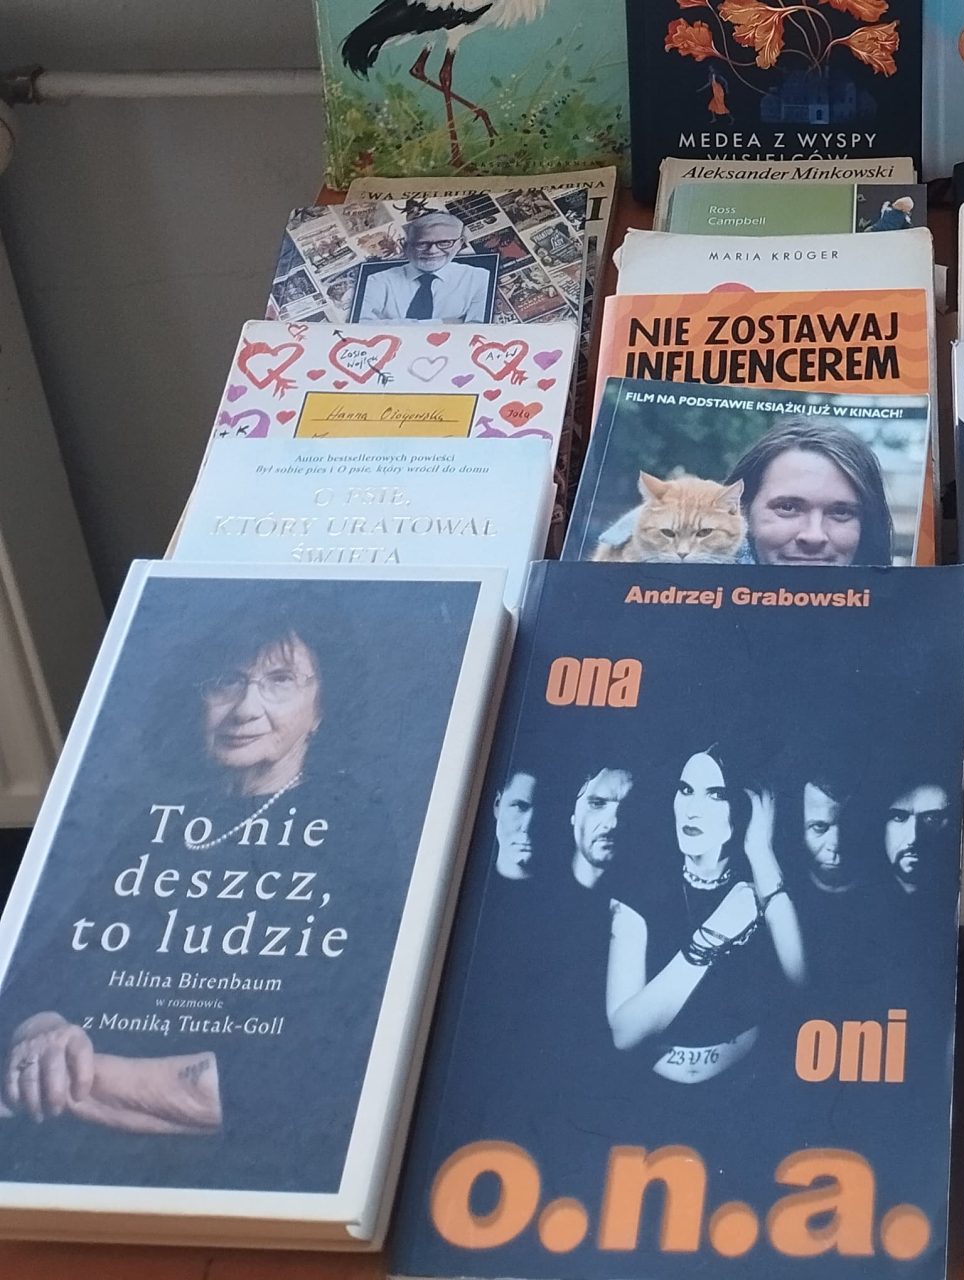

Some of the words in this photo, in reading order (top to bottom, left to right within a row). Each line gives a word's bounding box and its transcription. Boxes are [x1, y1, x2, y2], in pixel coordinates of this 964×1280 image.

[679, 133, 761, 147] MEDEA
[774, 133, 785, 147] Z
[798, 133, 877, 147] WYSPY
[682, 166, 789, 180] Aleksander
[791, 165, 894, 180] Minkowski
[708, 217, 765, 226] Campbell
[709, 206, 736, 214] Ross
[709, 251, 760, 261] MARIA
[772, 250, 839, 261] KRÜGER
[629, 318, 690, 346] NIE
[705, 312, 898, 345] ZOSTAWAJ
[625, 346, 899, 384] INFLUENCEREM
[326, 408, 368, 420] Hanna
[626, 392, 654, 402] FILM
[657, 394, 675, 405] NA
[679, 396, 753, 410] PODSTAWIE
[756, 401, 806, 415] KSIĄŻKI
[807, 403, 830, 416] JUŻ
[833, 407, 848, 416] W
[850, 408, 903, 418] KINACH!
[327, 454, 407, 463] bestsellerowych
[411, 454, 455, 463] powieści
[210, 512, 318, 537] KTÓRY
[327, 516, 497, 537] URATOWAŁ
[625, 586, 723, 609] Andrzej
[732, 587, 871, 607] Grabowski
[546, 656, 642, 708] ona
[150, 804, 213, 846] To
[238, 808, 329, 847] nie
[114, 855, 332, 908] deszcz,
[71, 917, 130, 952] to
[157, 909, 348, 957] ludzie
[109, 970, 172, 989] Halina
[179, 973, 282, 991] Birenbaum
[168, 997, 223, 1009] rozmowie
[83, 1016, 93, 1029] z
[98, 1012, 171, 1036] Moniką
[179, 1016, 284, 1034] Tutak-Goll
[795, 1009, 907, 1083] oni
[429, 1139, 931, 1260] o.n.a.
